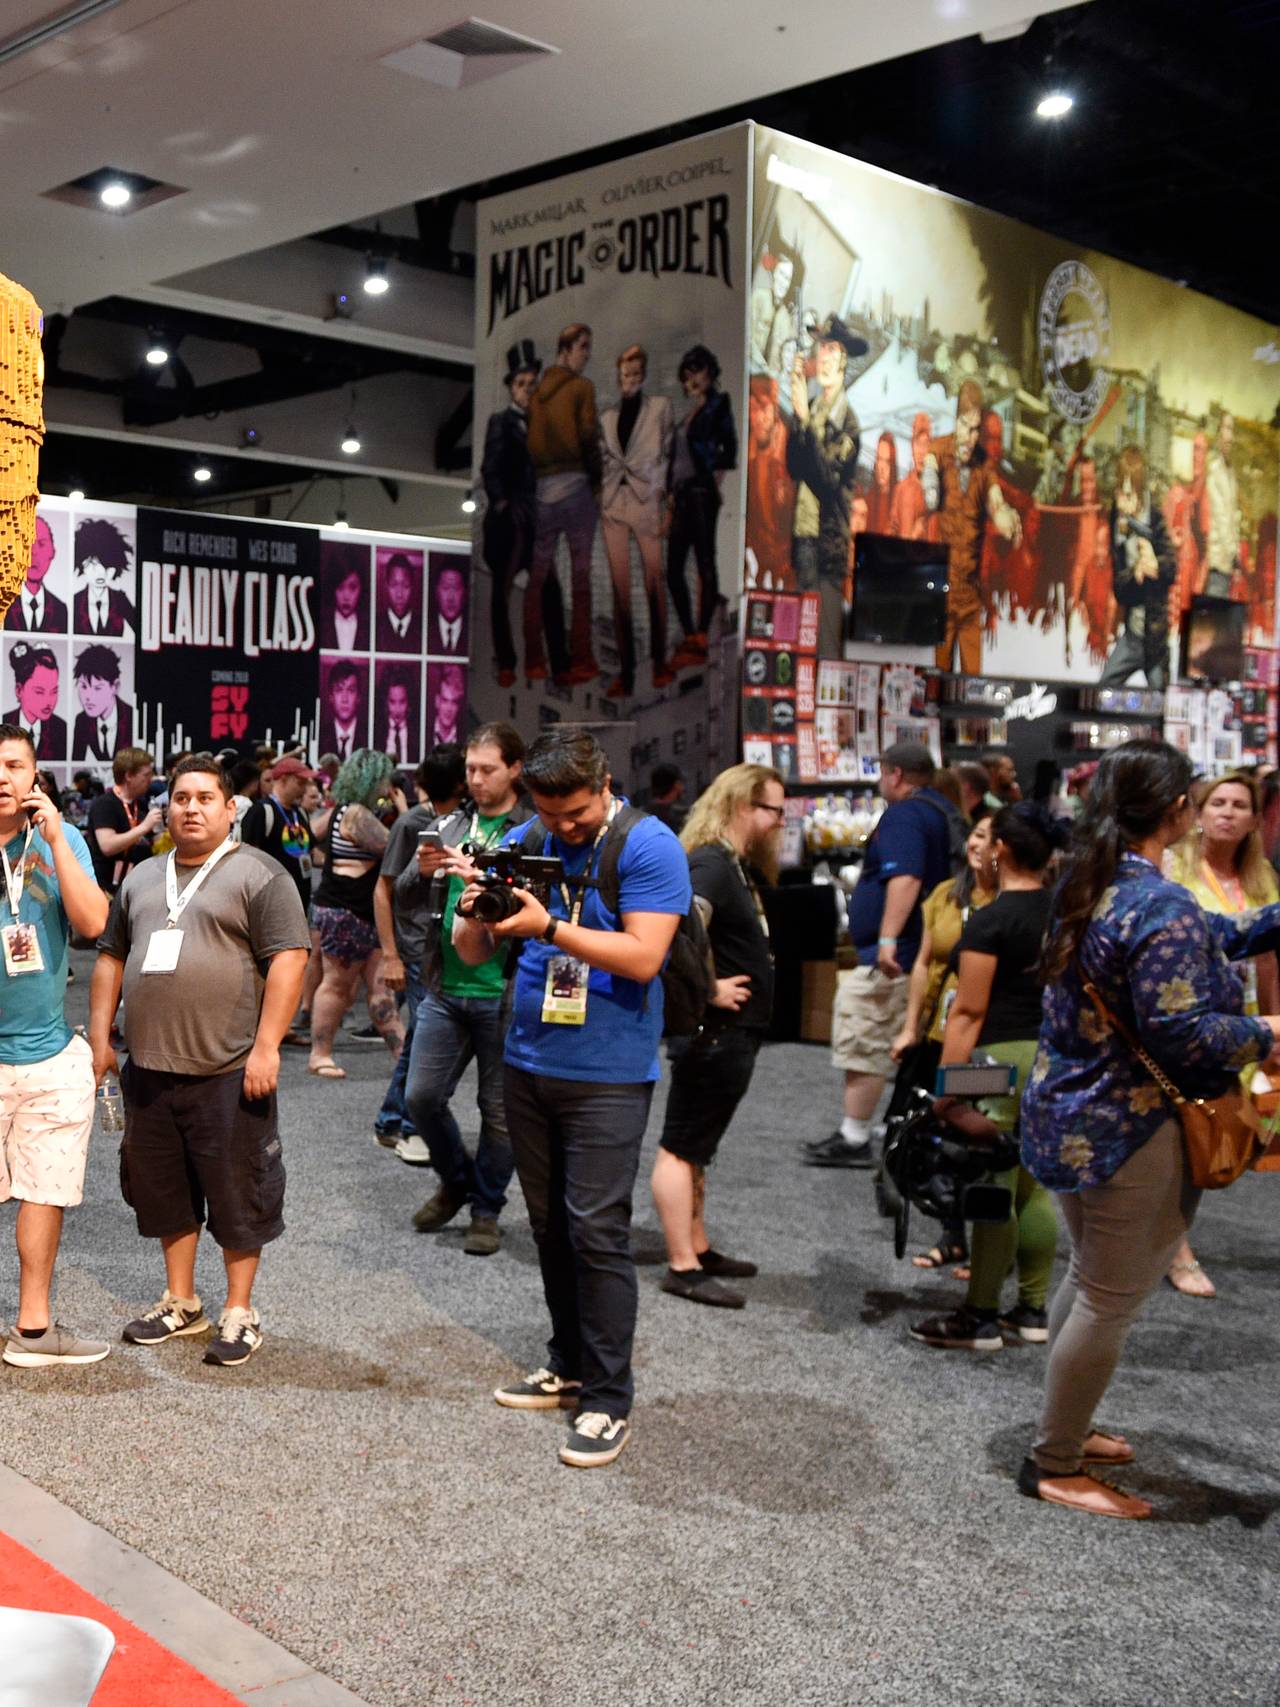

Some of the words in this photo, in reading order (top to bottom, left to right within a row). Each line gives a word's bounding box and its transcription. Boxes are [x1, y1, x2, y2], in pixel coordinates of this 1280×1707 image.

[486, 231, 586, 338] MAGIC
[616, 193, 733, 289] ORDER
[248, 538, 268, 563] WES
[270, 541, 297, 565] CRAIG
[141, 561, 239, 651] DEADLY
[243, 571, 315, 657] CLASS
